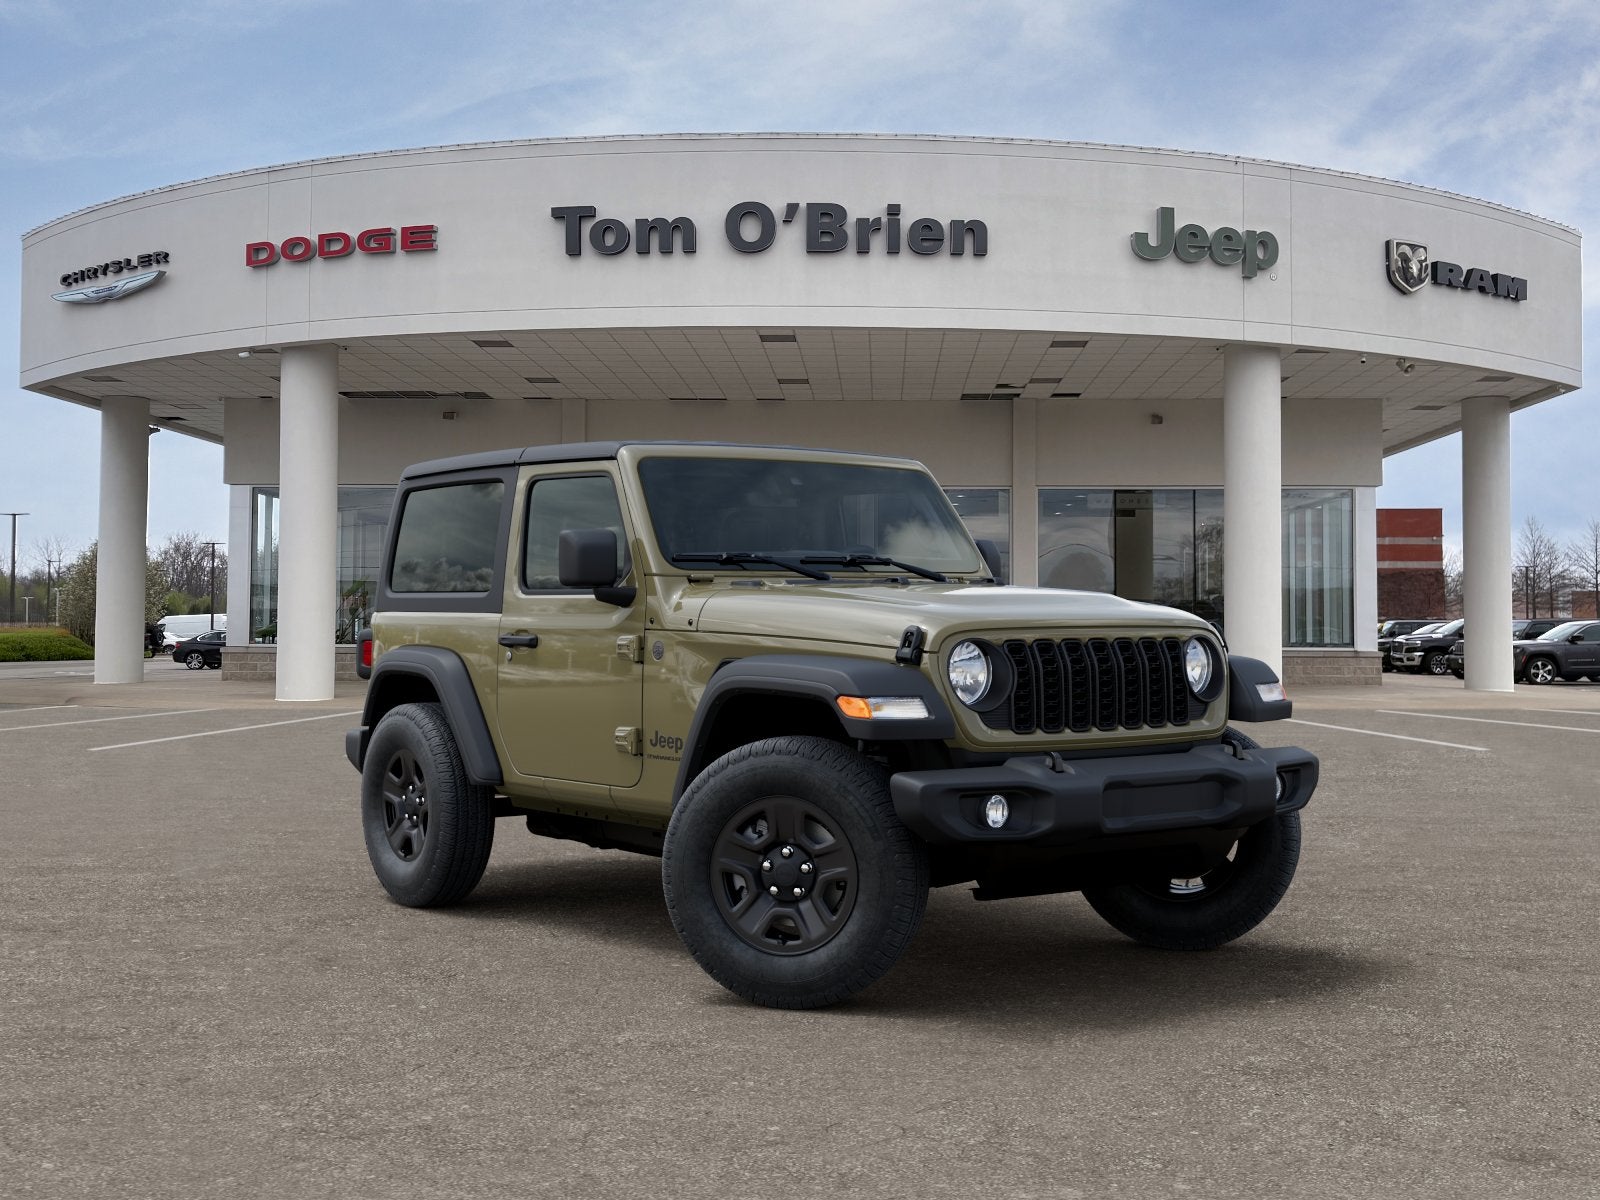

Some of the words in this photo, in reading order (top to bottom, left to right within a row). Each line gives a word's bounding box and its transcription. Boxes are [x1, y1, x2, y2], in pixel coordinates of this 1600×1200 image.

[245, 224, 438, 268] DODGE
[550, 206, 697, 256] Tom
[725, 201, 989, 257] O'Brien
[1131, 206, 1279, 278] Jeep
[60, 250, 170, 287] CHRYSLER
[1430, 260, 1528, 301] RAM
[650, 730, 684, 753] Jeep
